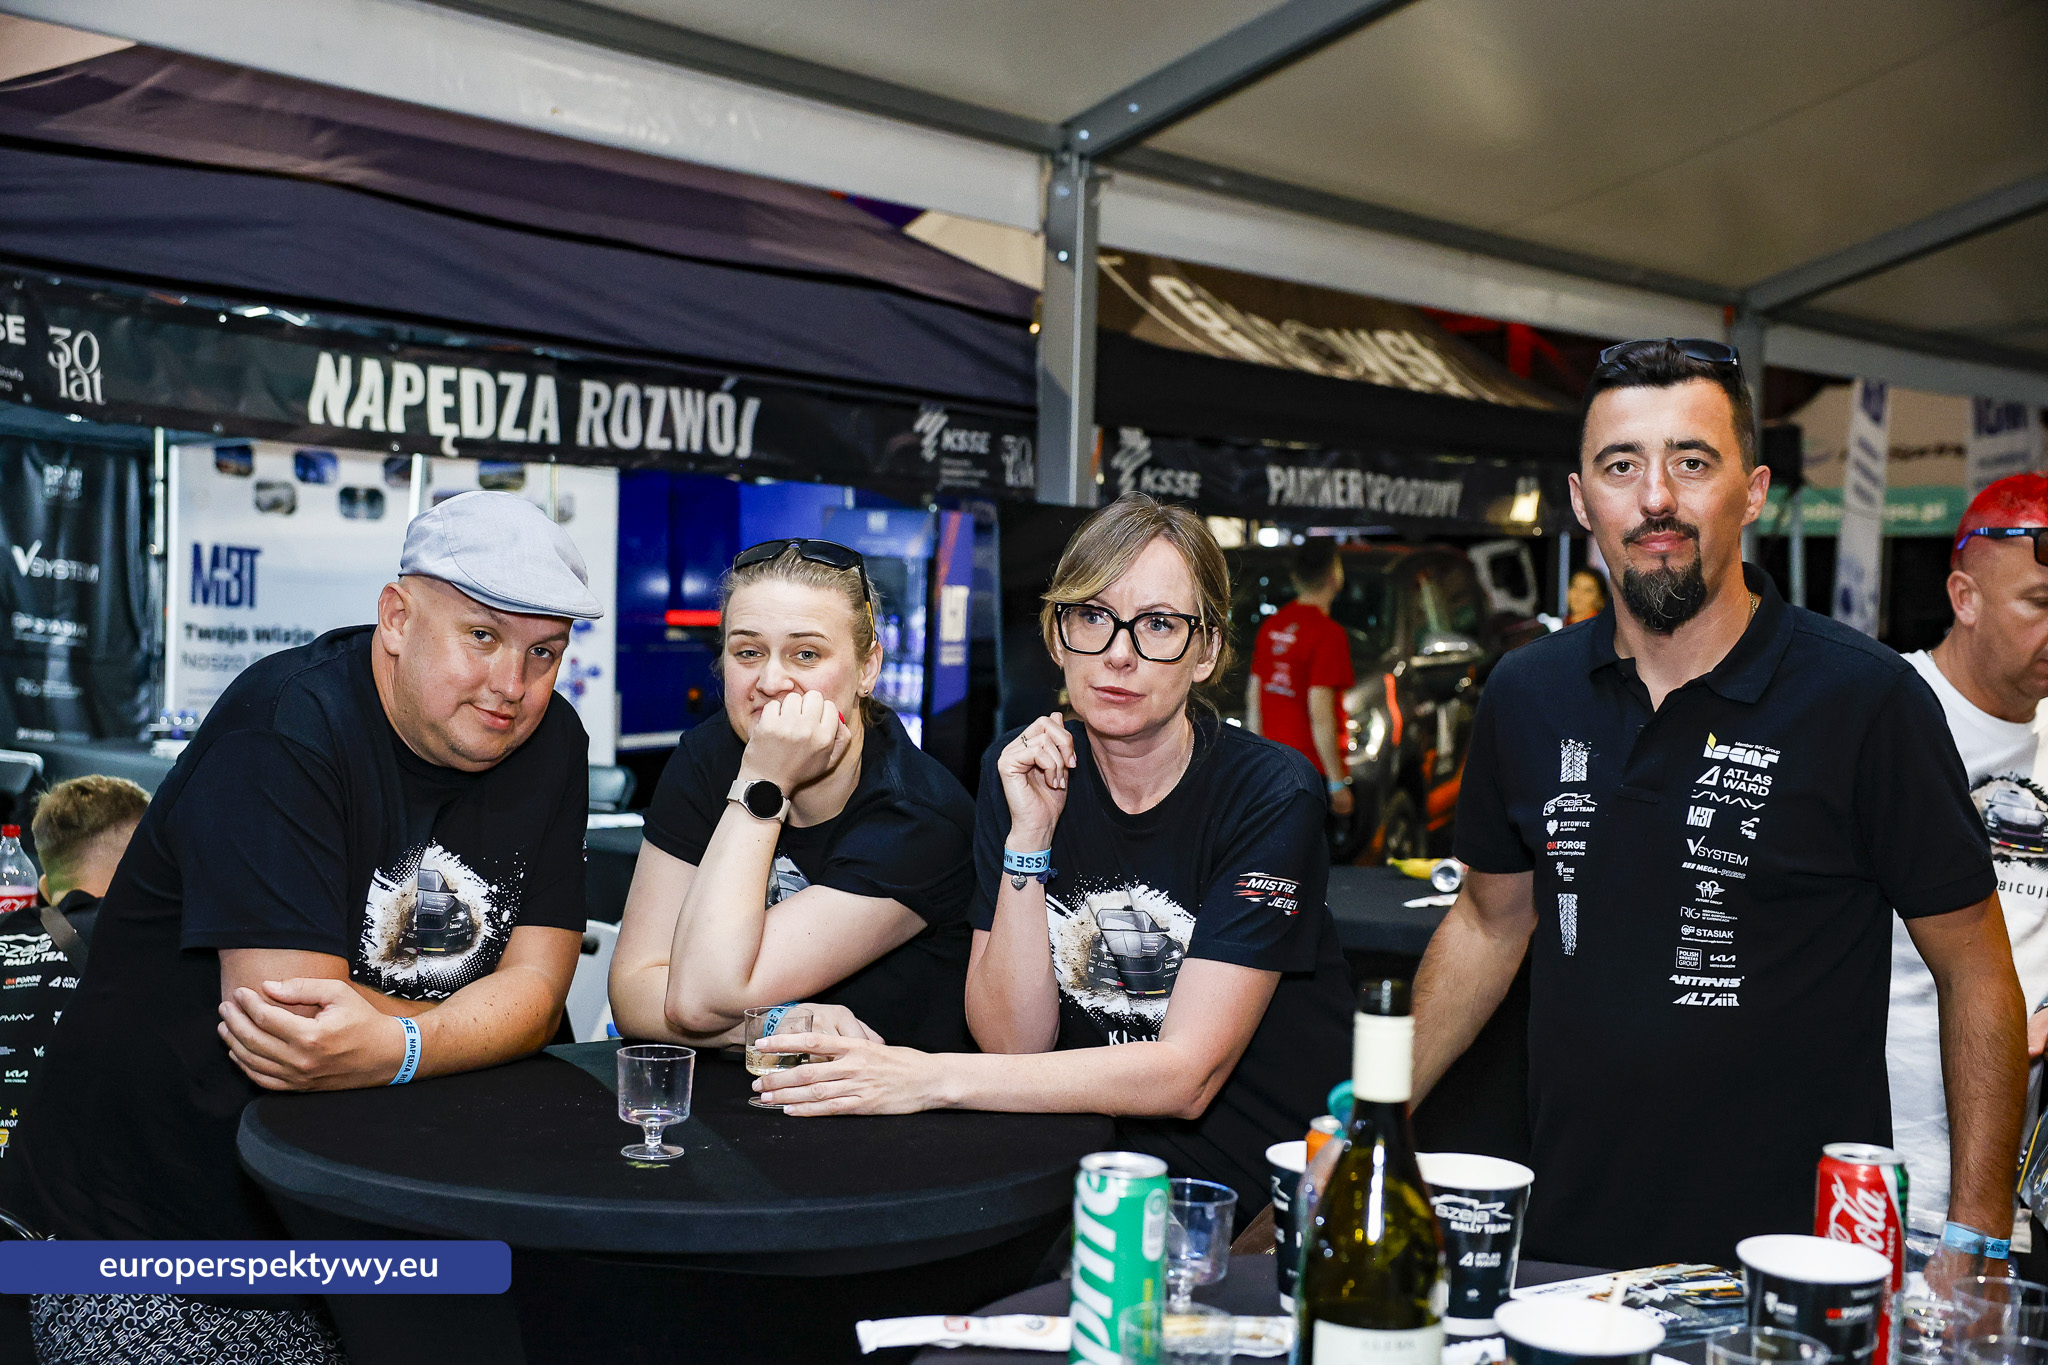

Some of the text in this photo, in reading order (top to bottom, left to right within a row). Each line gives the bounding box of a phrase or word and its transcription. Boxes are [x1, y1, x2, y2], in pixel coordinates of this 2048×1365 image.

[48, 325, 100, 374] 30
[308, 352, 762, 460] NAPĘDZA ROZWÓJ
[191, 543, 263, 609] MBT
[1724, 768, 1773, 786] ATLAS
[1722, 778, 1770, 796] WARD
[1691, 789, 1765, 810] SMAY
[1686, 805, 1716, 828] MBT
[1546, 841, 1587, 850] GKFORGE
[1016, 854, 1048, 868] KSSE
[1245, 878, 1297, 894] MISTRZ
[1998, 880, 2048, 898] BICUJ
[1680, 906, 1701, 919] RIG
[1695, 928, 1734, 939] STASIAK
[3, 954, 40, 967] RALLY
[1709, 954, 1736, 962] KIA
[1672, 991, 1740, 1007] ALTAIR
[403, 1038, 417, 1073] NAPĘDZA
[1484, 1222, 1511, 1235] TEAM
[1070, 1170, 1122, 1365] prite
